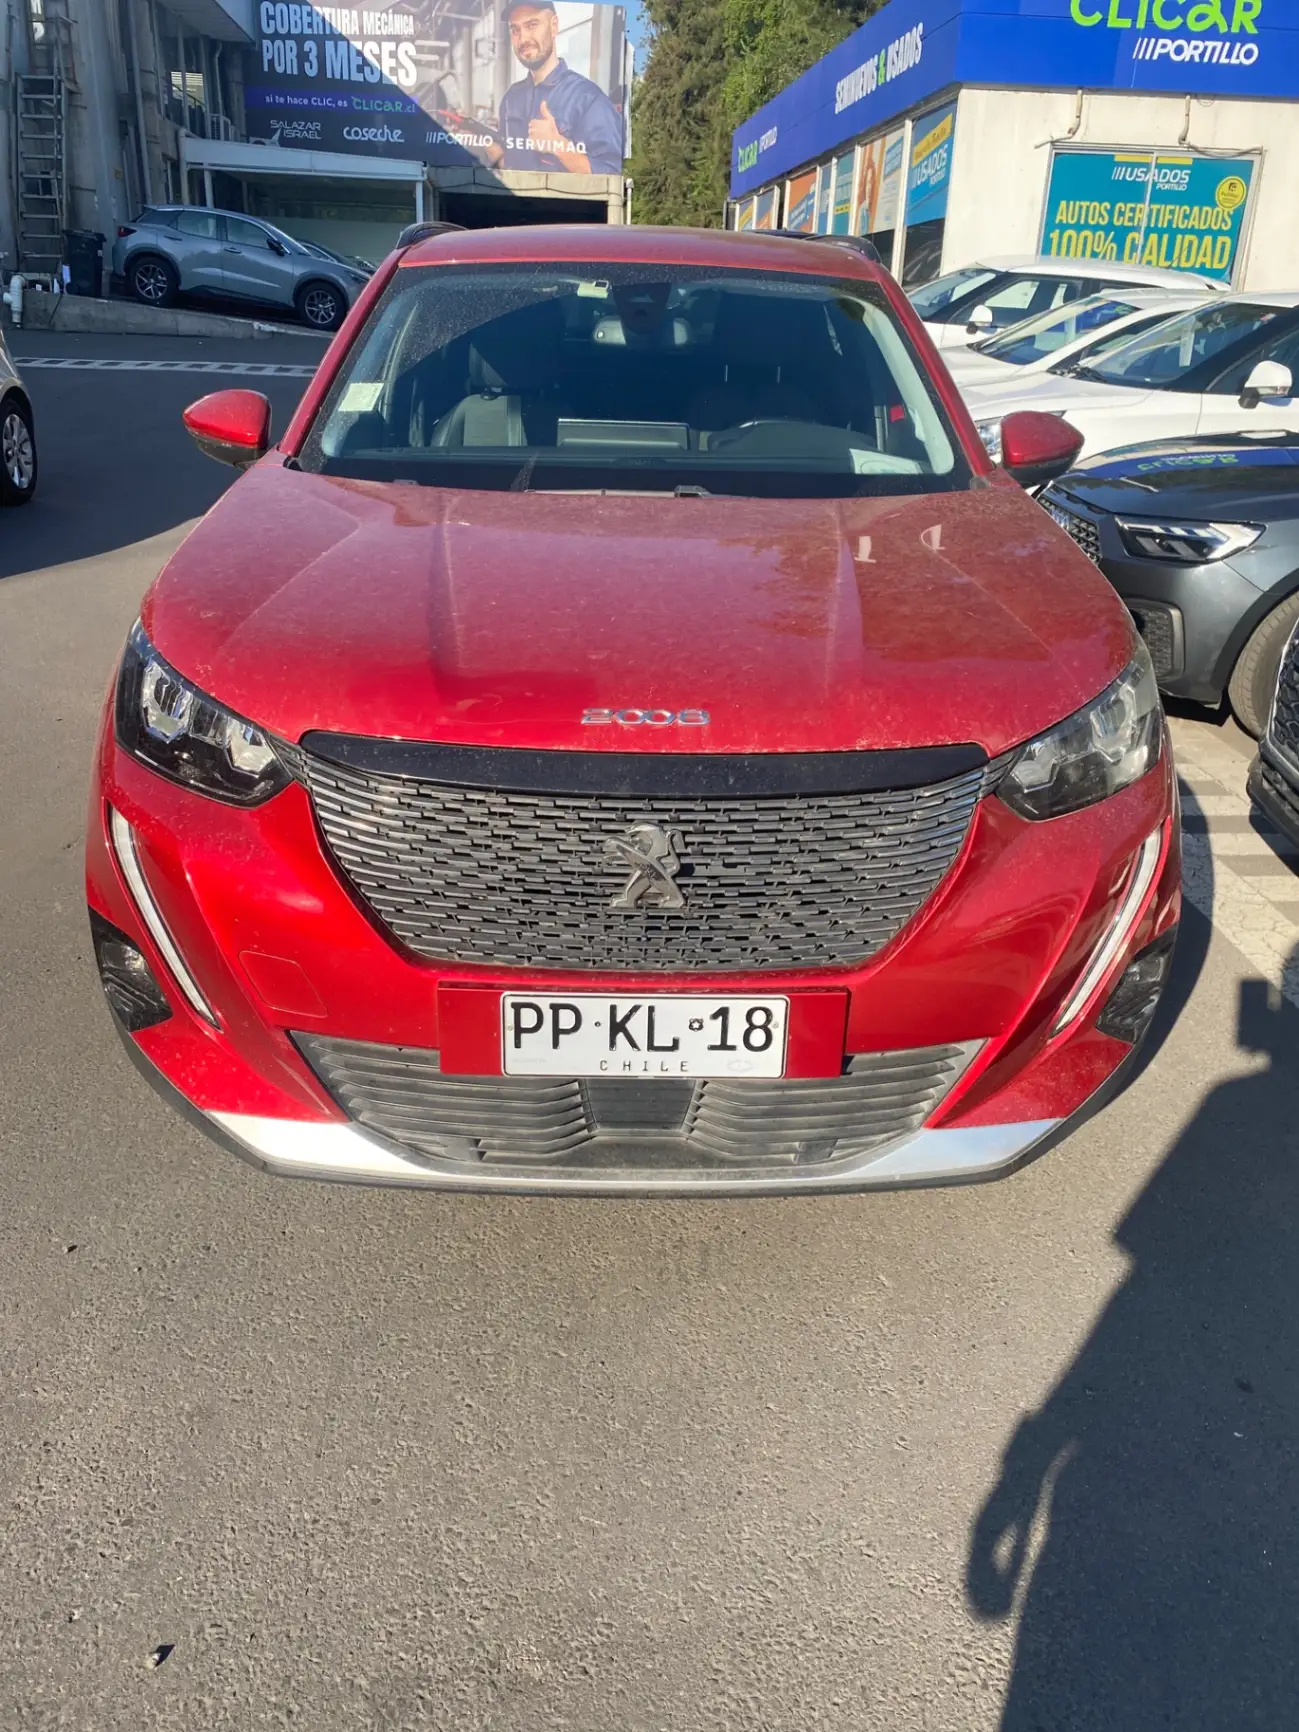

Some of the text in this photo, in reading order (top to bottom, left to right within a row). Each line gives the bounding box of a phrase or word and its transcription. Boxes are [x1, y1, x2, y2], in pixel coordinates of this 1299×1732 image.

[260, 1, 415, 36] COBERTURA MECÁNICA
[262, 39, 418, 87] POR 3 MESES
[287, 96, 308, 105] hace
[311, 97, 336, 108] CLIC,
[270, 119, 322, 131] SALAZAR
[283, 129, 322, 139] ISRAEL
[506, 137, 588, 154] SERVIMAQ
[1055, 200, 1234, 231] AUTOS CERTIFICADOS
[1050, 229, 1232, 269] 100% CALIDAD
[581, 707, 711, 725] 2008
[600, 1060, 689, 1072] CHILE
